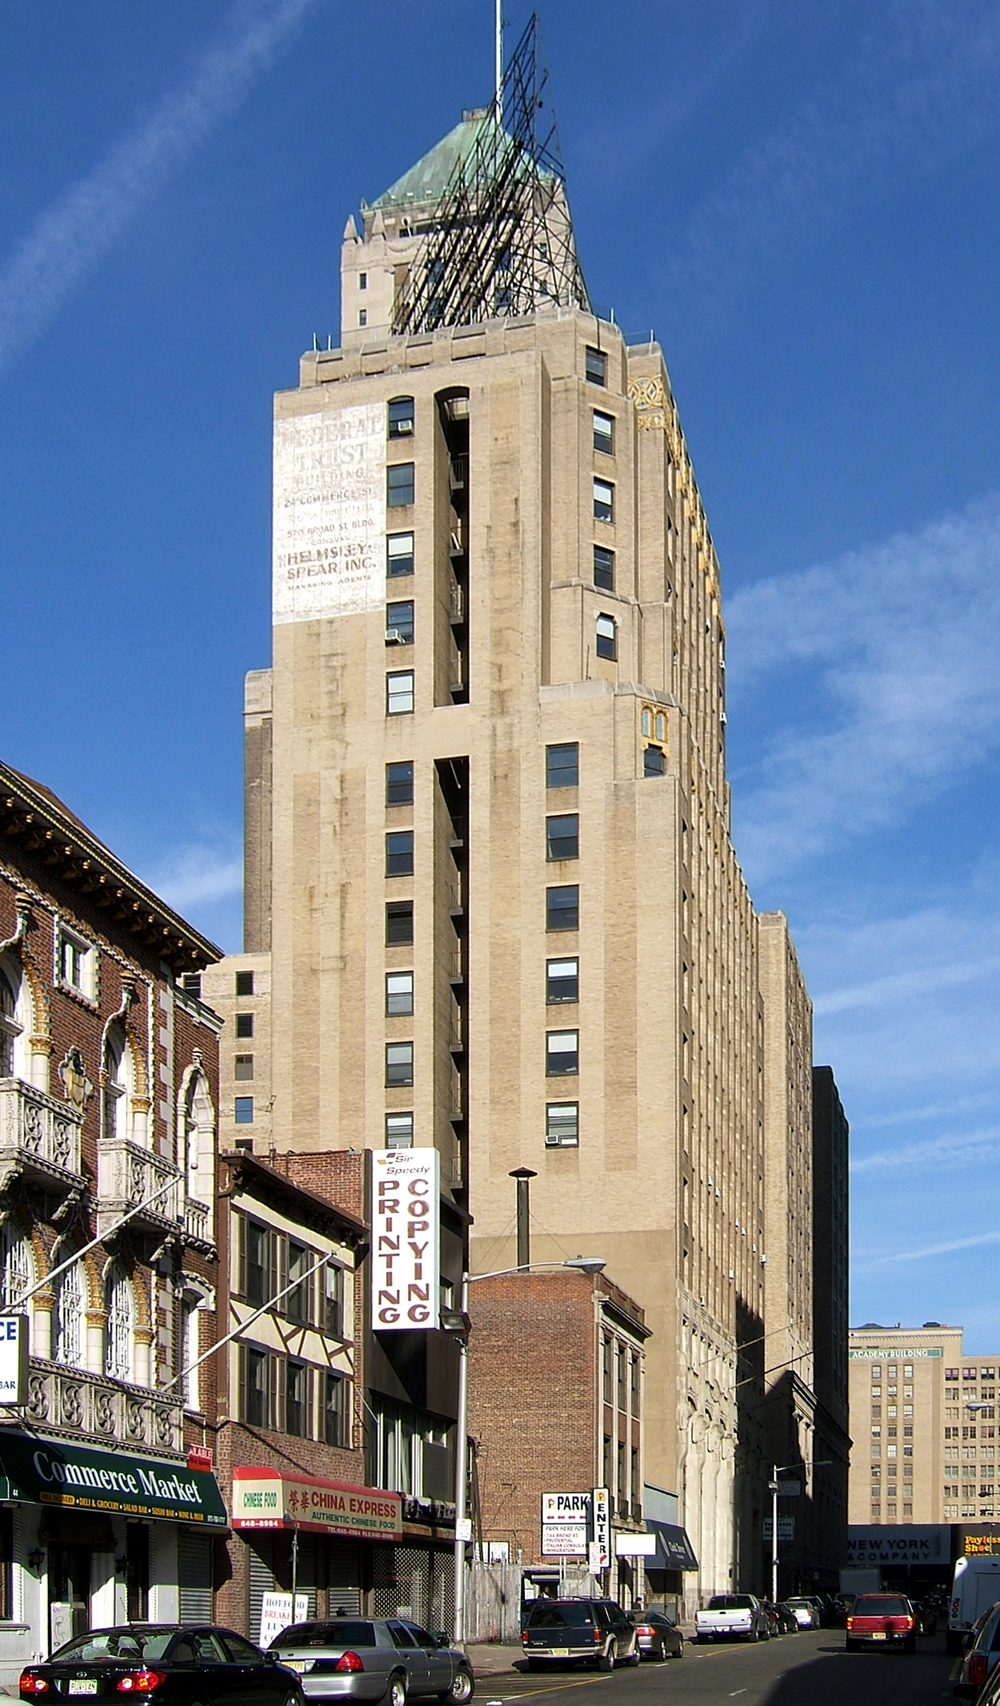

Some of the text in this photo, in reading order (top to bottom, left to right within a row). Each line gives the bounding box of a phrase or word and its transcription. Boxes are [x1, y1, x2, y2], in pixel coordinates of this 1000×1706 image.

[345, 556, 377, 572] INC.
[337, 573, 372, 584] AGENTS
[386, 1154, 430, 1176] Sir Speedy
[378, 1180, 400, 1324] PRINTING
[407, 1178, 430, 1323] COPYING
[852, 1349, 928, 1358] ACADEMY BUILDING
[33, 1451, 203, 1504] Commerce Market
[80, 1497, 91, 1506] DELI
[97, 1500, 119, 1510] GROCERY
[123, 1503, 137, 1512] SALAD
[138, 1505, 147, 1514] BAR
[243, 1492, 277, 1508] CHINESE FOOD
[311, 1491, 346, 1512] CHINA
[350, 1498, 397, 1518] EXPRESS
[557, 1496, 588, 1511] PARK
[240, 1520, 278, 1528] 648-8984
[311, 1511, 395, 1530] AUTHENTIC CHINESE FOOD
[596, 1503, 607, 1554] ENTER
[847, 1539, 930, 1550] NEW YORK
[266, 1598, 282, 1608] HOT
[264, 1610, 304, 1621] BREAKFST
